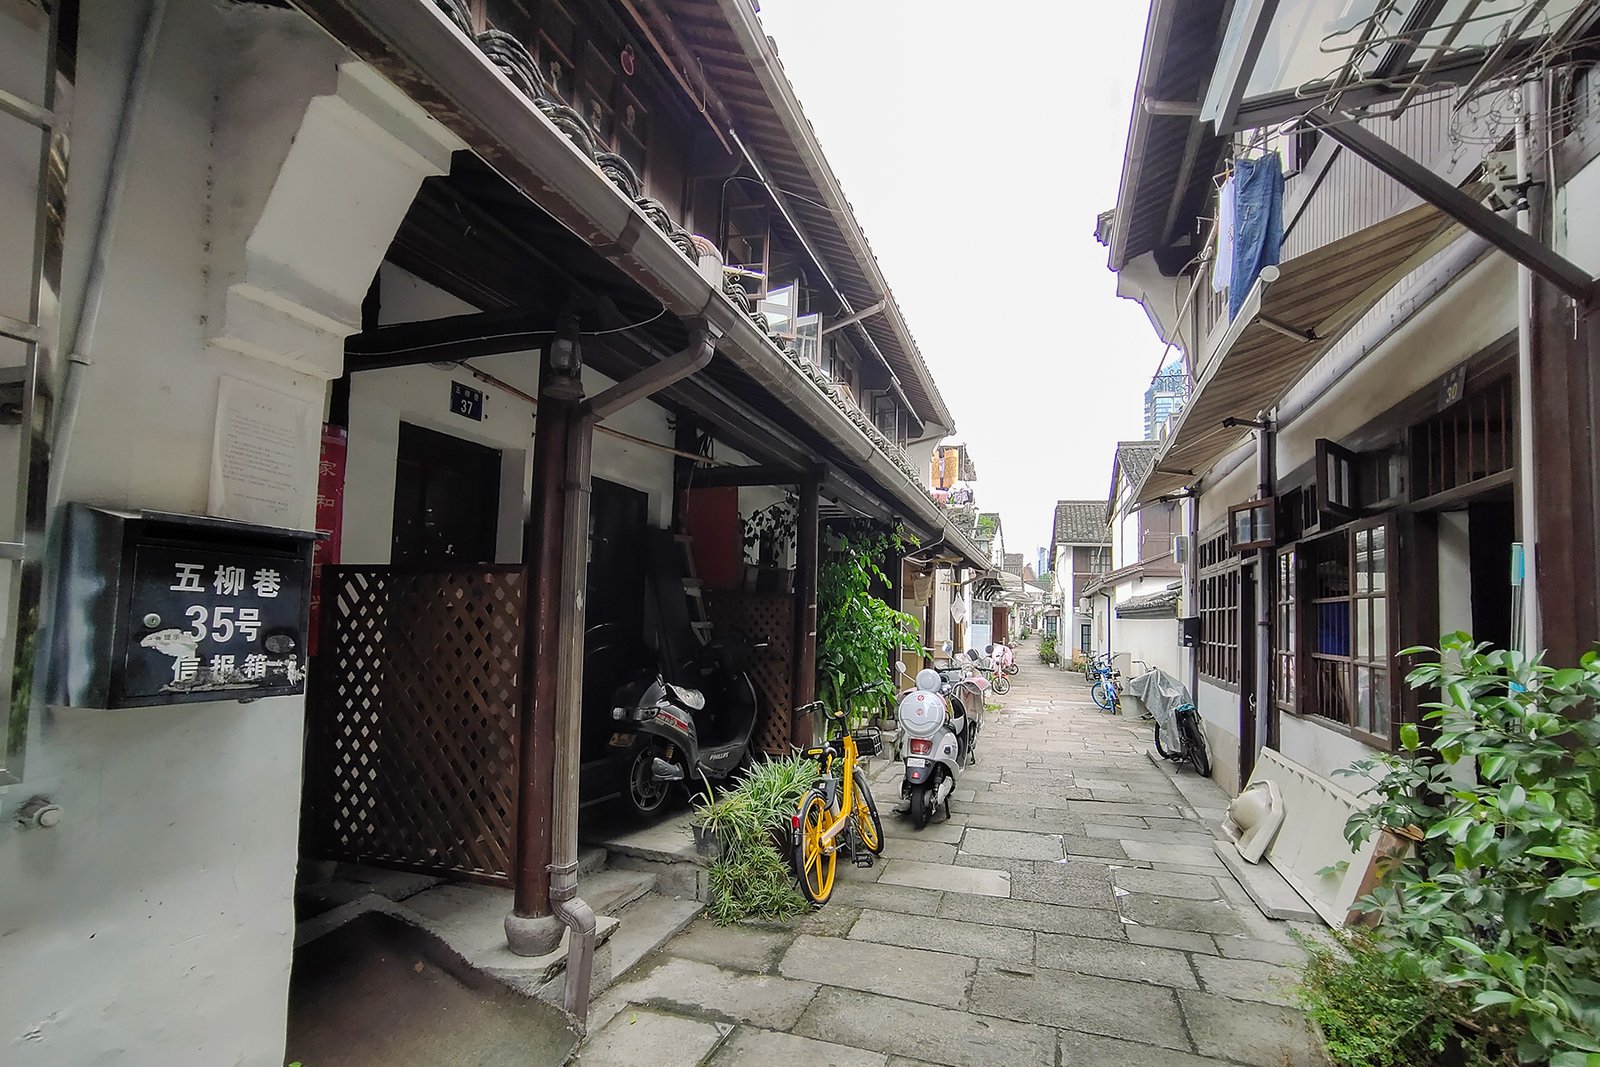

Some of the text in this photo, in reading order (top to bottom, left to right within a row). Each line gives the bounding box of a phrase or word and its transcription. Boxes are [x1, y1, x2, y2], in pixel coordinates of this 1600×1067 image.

[460, 399, 473, 415] 37
[1446, 382, 1458, 403] 30
[169, 562, 282, 598] 五柳巷
[184, 604, 262, 643] 35号
[169, 653, 268, 686] 信报箱
